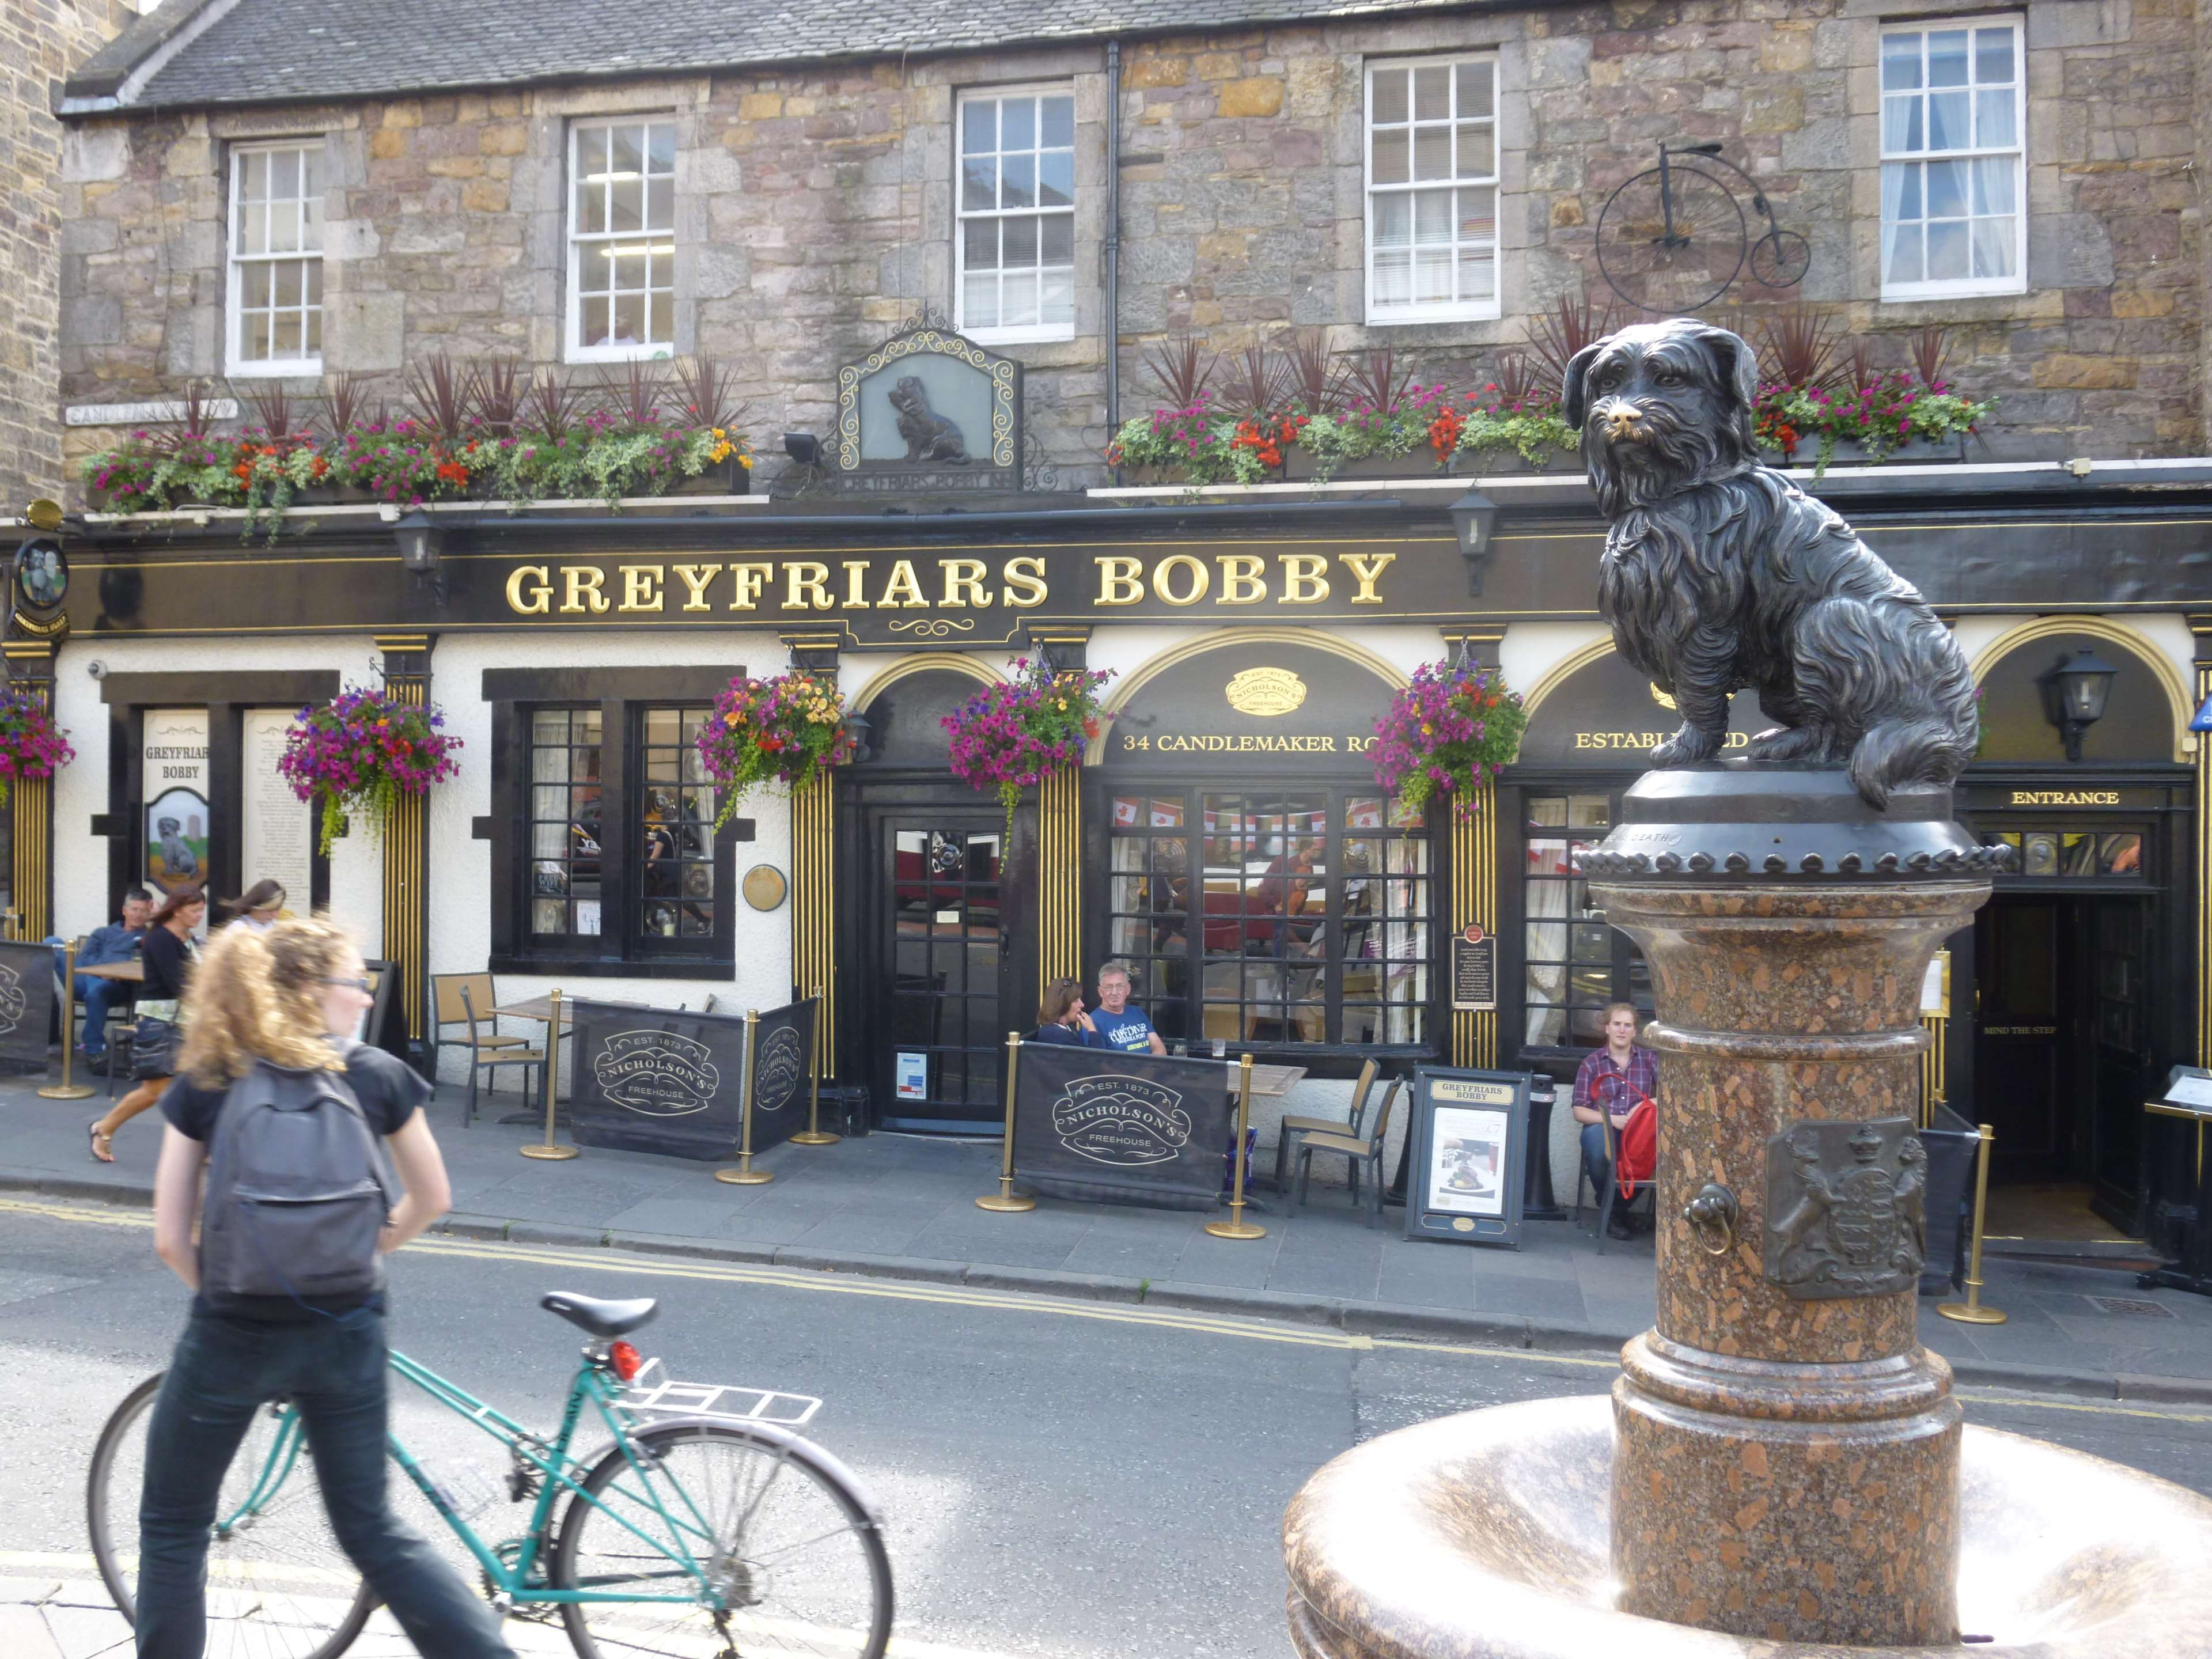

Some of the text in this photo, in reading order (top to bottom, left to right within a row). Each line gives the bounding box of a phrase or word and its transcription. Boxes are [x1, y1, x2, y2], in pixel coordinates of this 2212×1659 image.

[505, 553, 1396, 615] GREYFRIARS BOBBY
[1123, 734, 1150, 751] 34
[1157, 734, 1336, 752] CANDLEMAKER
[146, 746, 209, 759] GREYFRIAR
[162, 766, 199, 778] BOBBY
[2012, 791, 2120, 805] ENTRANCE
[1984, 1026, 2056, 1035] MIND THE STEP
[634, 1037, 681, 1050] EST. 1873
[608, 1059, 707, 1089] NICHOLSON'S
[628, 1086, 684, 1099] FREEHOUSE
[1098, 1082, 1149, 1095] EST. 1873
[1442, 1084, 1503, 1094] GREYFRIARS
[1456, 1092, 1487, 1100] BOBBY
[1067, 1105, 1177, 1137] NICHOLSON'S
[1089, 1134, 1152, 1147] FREEHOUSE
